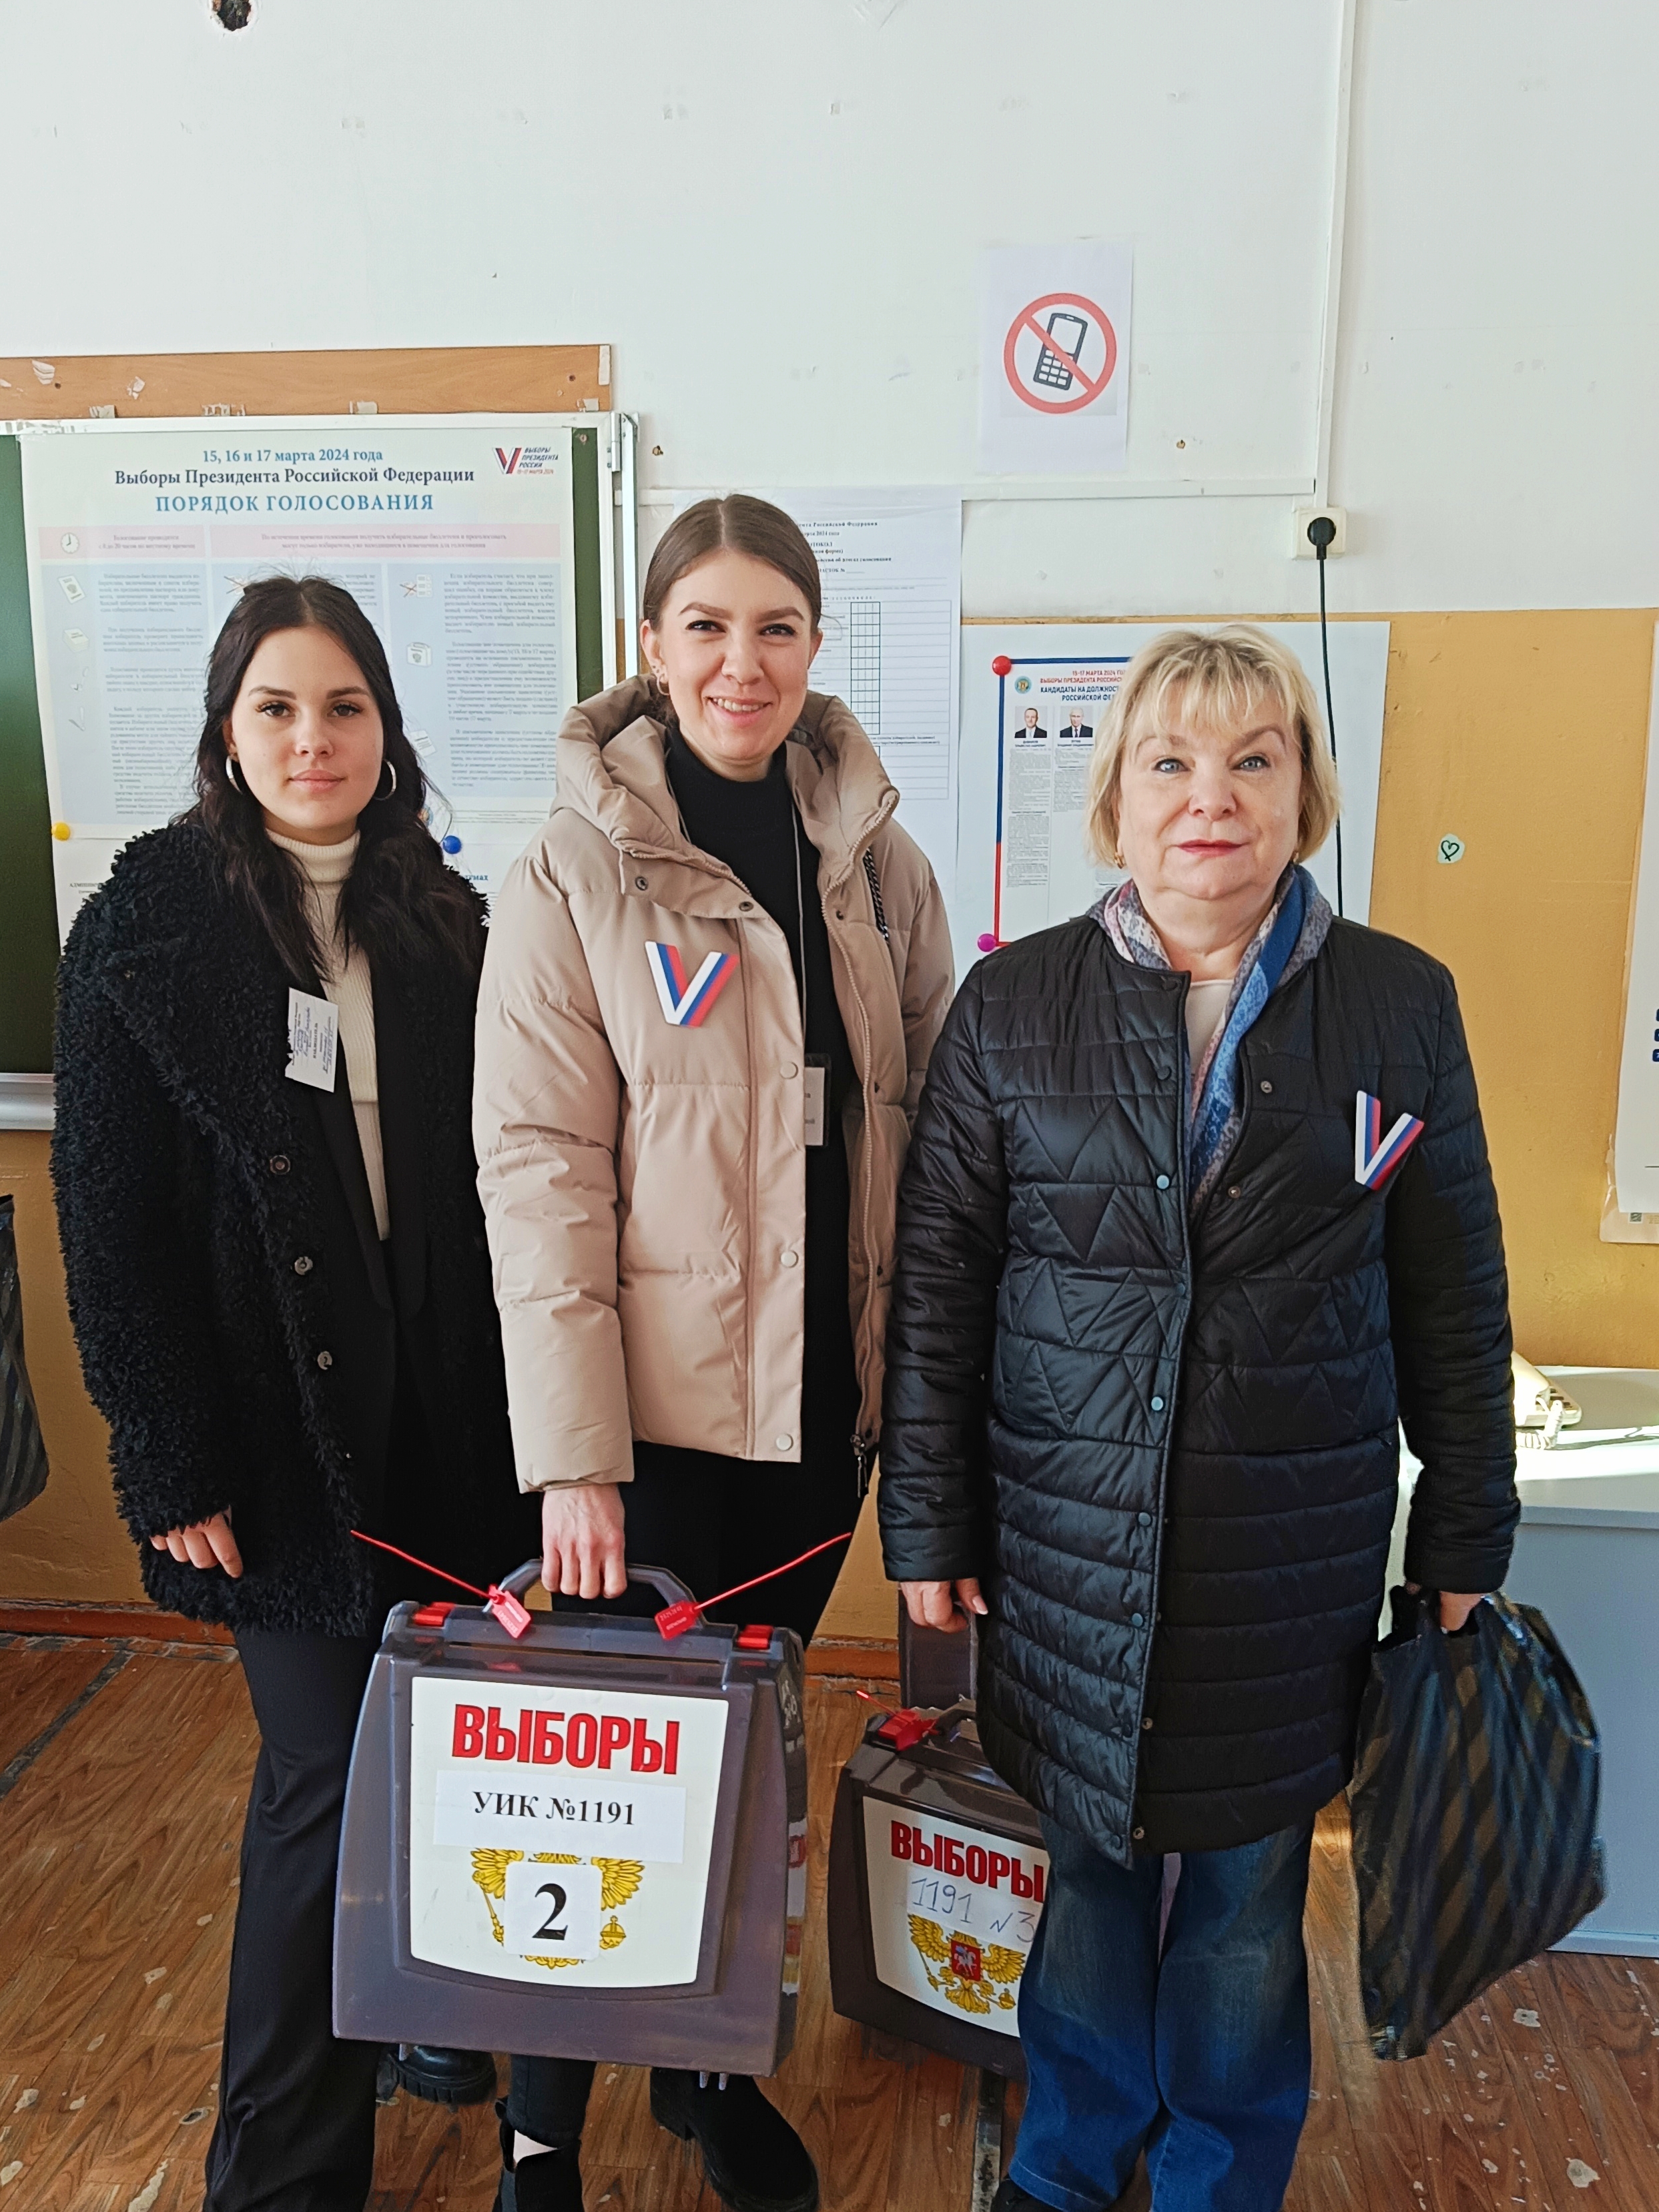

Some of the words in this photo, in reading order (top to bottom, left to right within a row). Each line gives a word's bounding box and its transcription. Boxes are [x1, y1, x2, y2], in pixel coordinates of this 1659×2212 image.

[203, 449, 222, 464] 15,
[226, 449, 240, 462] 16
[244, 452, 253, 462] и
[257, 449, 272, 462] 17
[275, 452, 316, 464] марта
[319, 448, 350, 461] 2024
[353, 450, 383, 462] года
[115, 469, 180, 487] Выборы
[186, 469, 280, 486] Президента
[284, 466, 378, 484] Российской
[383, 467, 474, 485] Федерации
[155, 496, 260, 514] ПОРЯДОК
[267, 494, 434, 511] ГОЛОСОВАНИЯ
[452, 1704, 679, 1775] ВЫБОРЫ
[472, 1791, 538, 1818] УИК
[546, 1796, 634, 1825] №1191
[891, 1820, 1044, 1903] ВЫБОРЫ
[531, 1882, 568, 1940] 2
[912, 1878, 972, 1924] 1191
